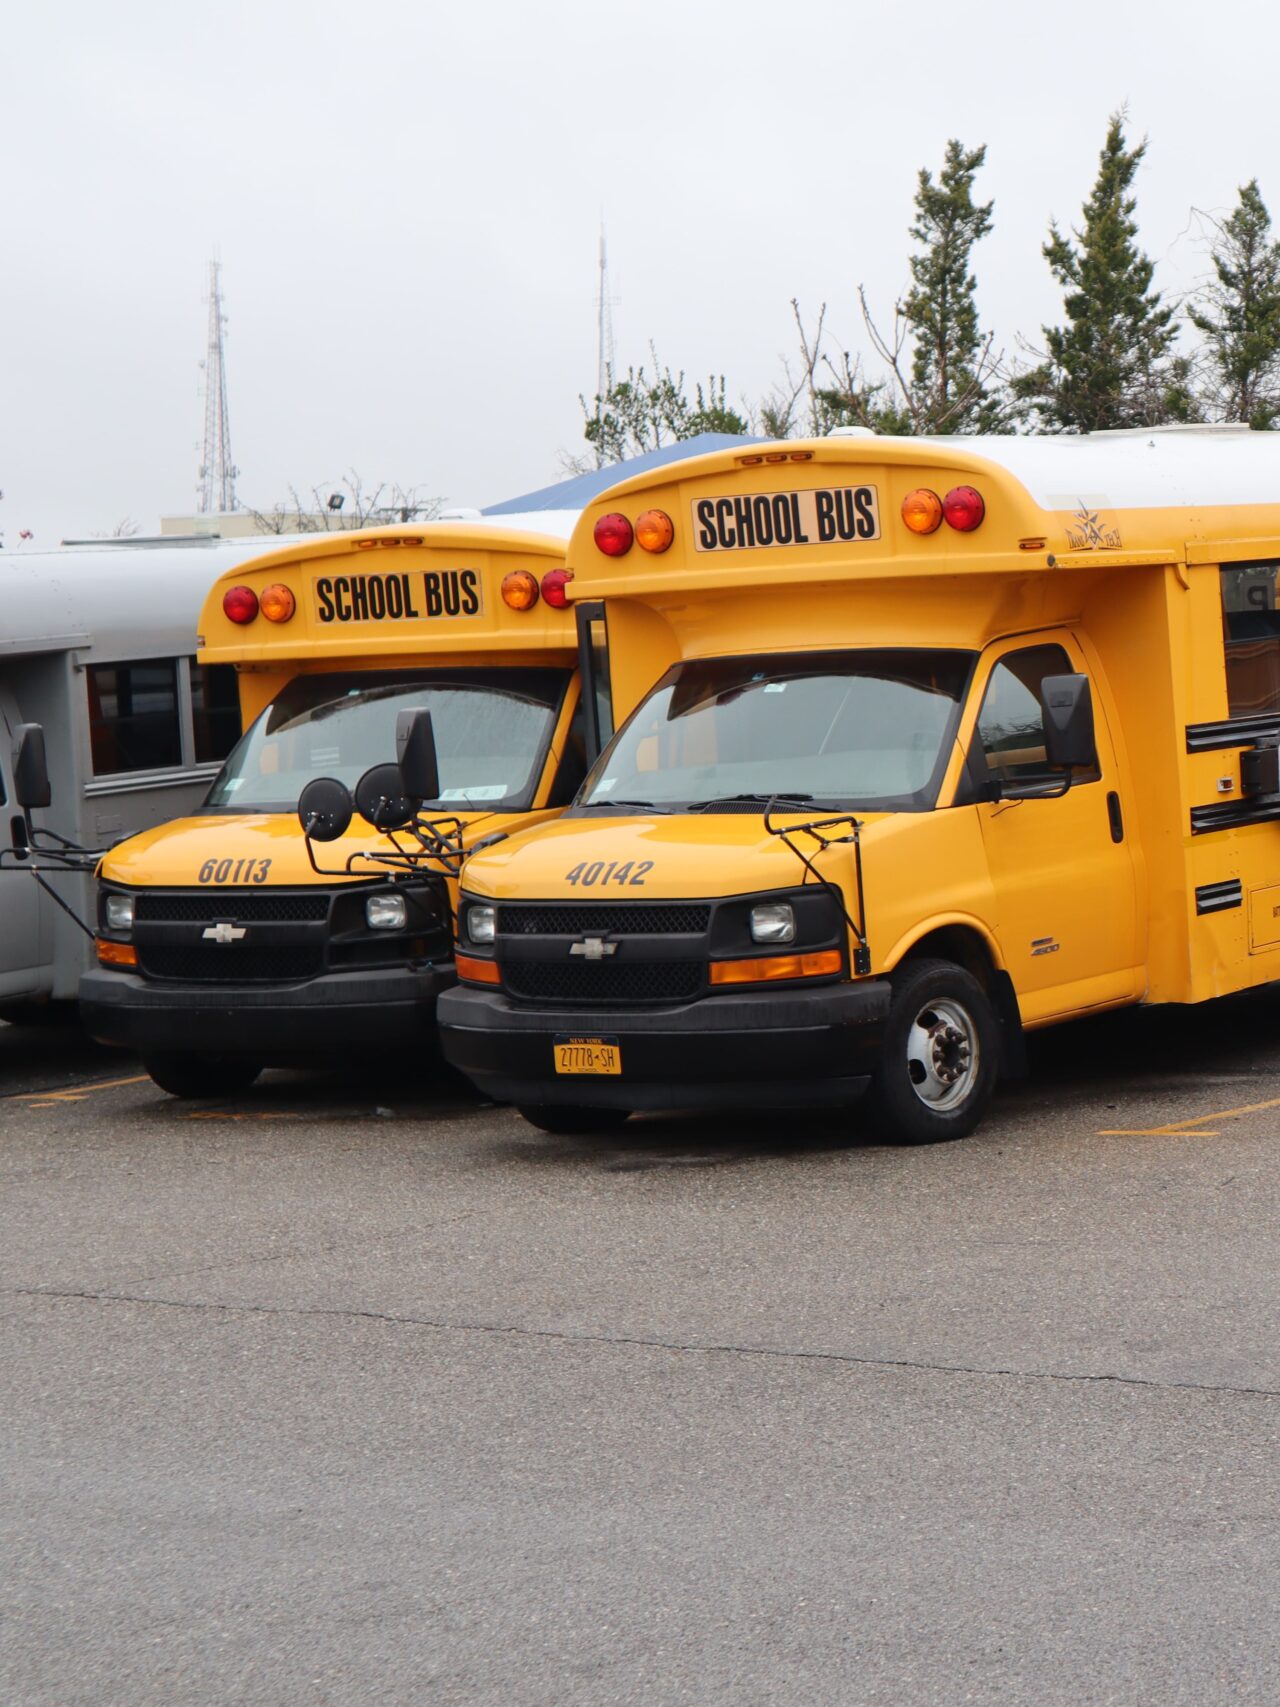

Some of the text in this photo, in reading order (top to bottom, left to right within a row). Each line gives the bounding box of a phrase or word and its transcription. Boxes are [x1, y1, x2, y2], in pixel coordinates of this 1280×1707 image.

[697, 488, 875, 549] SCHOOL BUS
[316, 570, 479, 622] SCHOOL BUS
[198, 858, 272, 883] 60113
[565, 860, 655, 886] 40142
